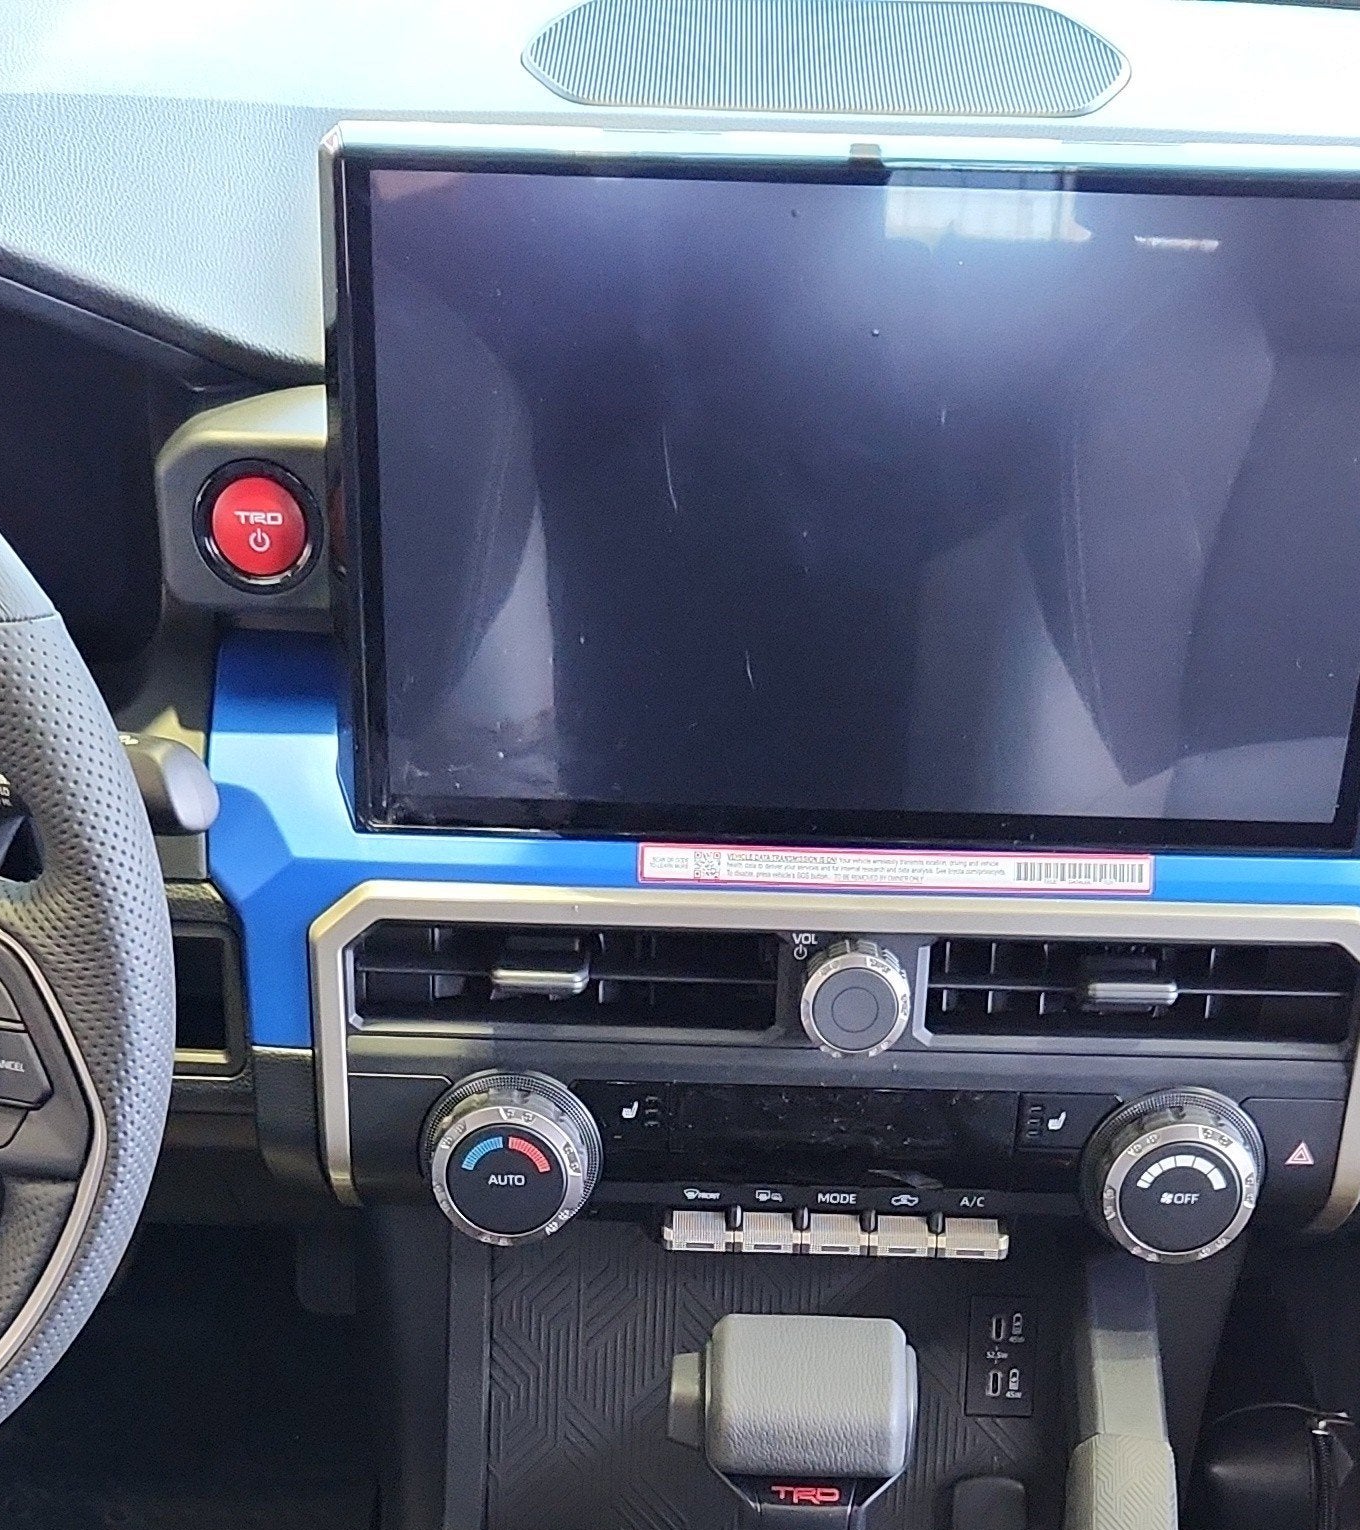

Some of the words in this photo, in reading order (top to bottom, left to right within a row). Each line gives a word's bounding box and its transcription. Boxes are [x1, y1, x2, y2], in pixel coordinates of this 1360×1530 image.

[234, 511, 284, 526] TRD
[792, 933, 818, 945] VOL
[488, 1174, 526, 1186] AUTO
[817, 1192, 857, 1205] MODE
[959, 1196, 985, 1208] A/C
[1173, 1193, 1200, 1205] OFF
[771, 1485, 841, 1505] TRD
